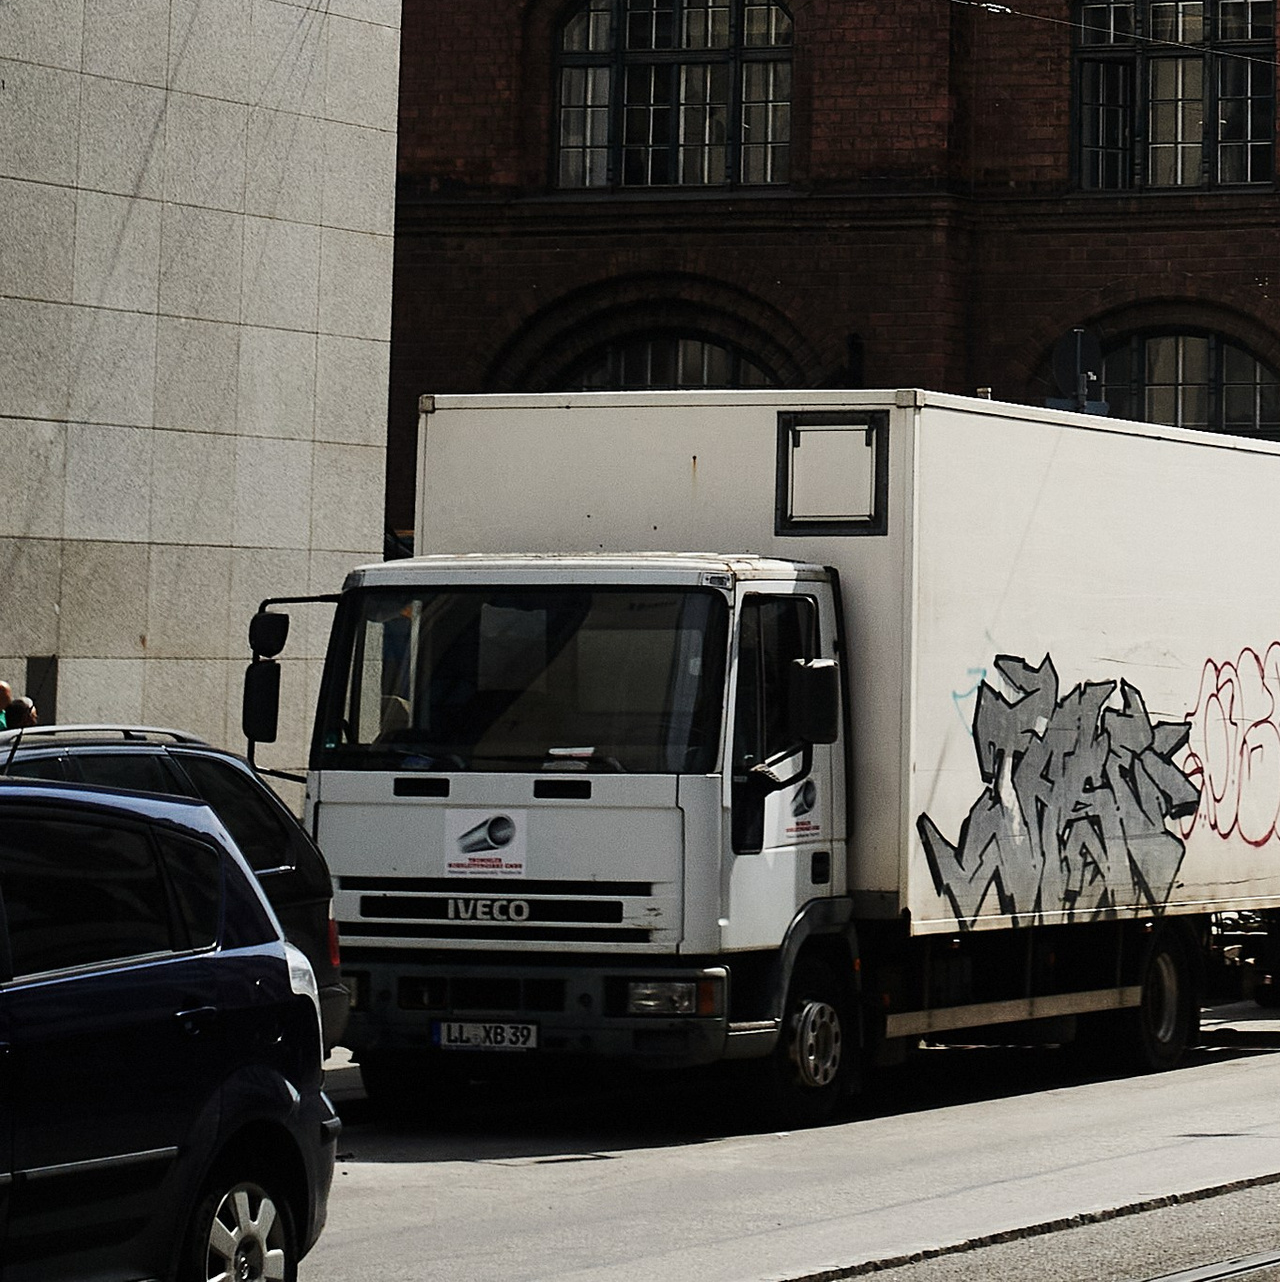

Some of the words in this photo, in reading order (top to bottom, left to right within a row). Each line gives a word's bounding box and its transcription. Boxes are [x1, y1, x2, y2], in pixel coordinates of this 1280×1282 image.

[447, 899, 530, 921] IVECO
[481, 1025, 506, 1046] XB
[508, 1025, 532, 1046] 39
